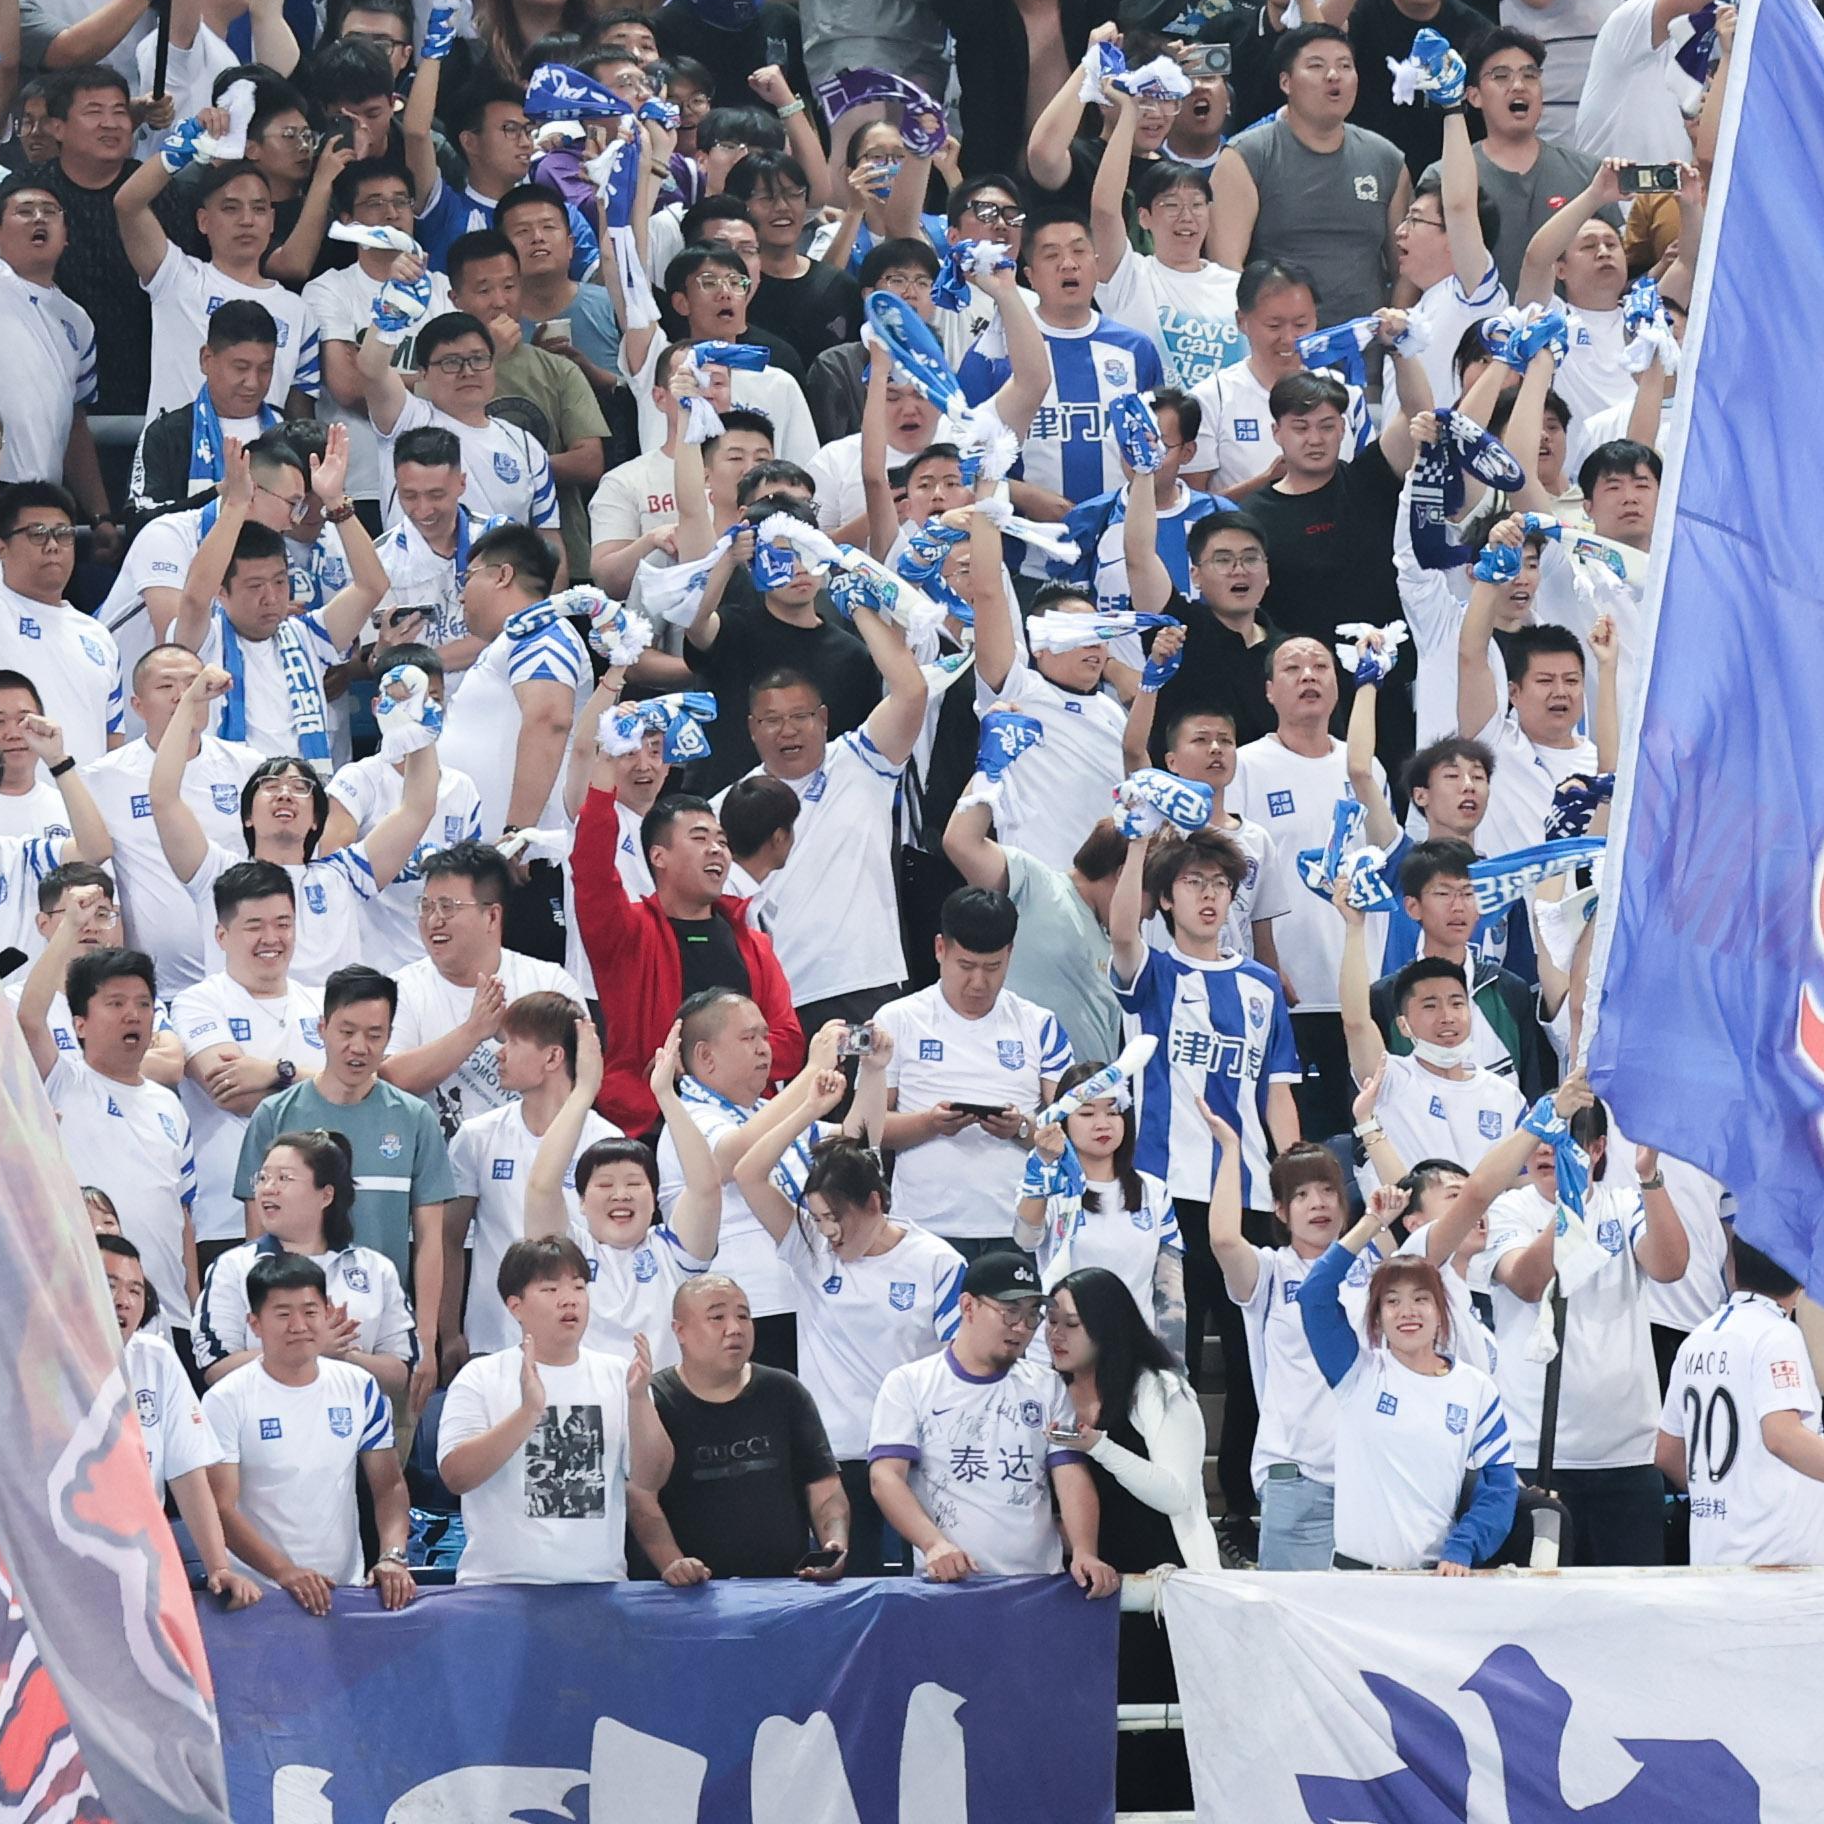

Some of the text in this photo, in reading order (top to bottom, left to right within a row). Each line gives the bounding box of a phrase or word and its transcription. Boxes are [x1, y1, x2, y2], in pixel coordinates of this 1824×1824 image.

[1157, 305, 1238, 346] Love
[1176, 334, 1222, 361] can
[151, 562, 179, 574] 2023
[696, 1435, 772, 1464] GUCCI
[950, 1444, 1035, 1484] 泰达
